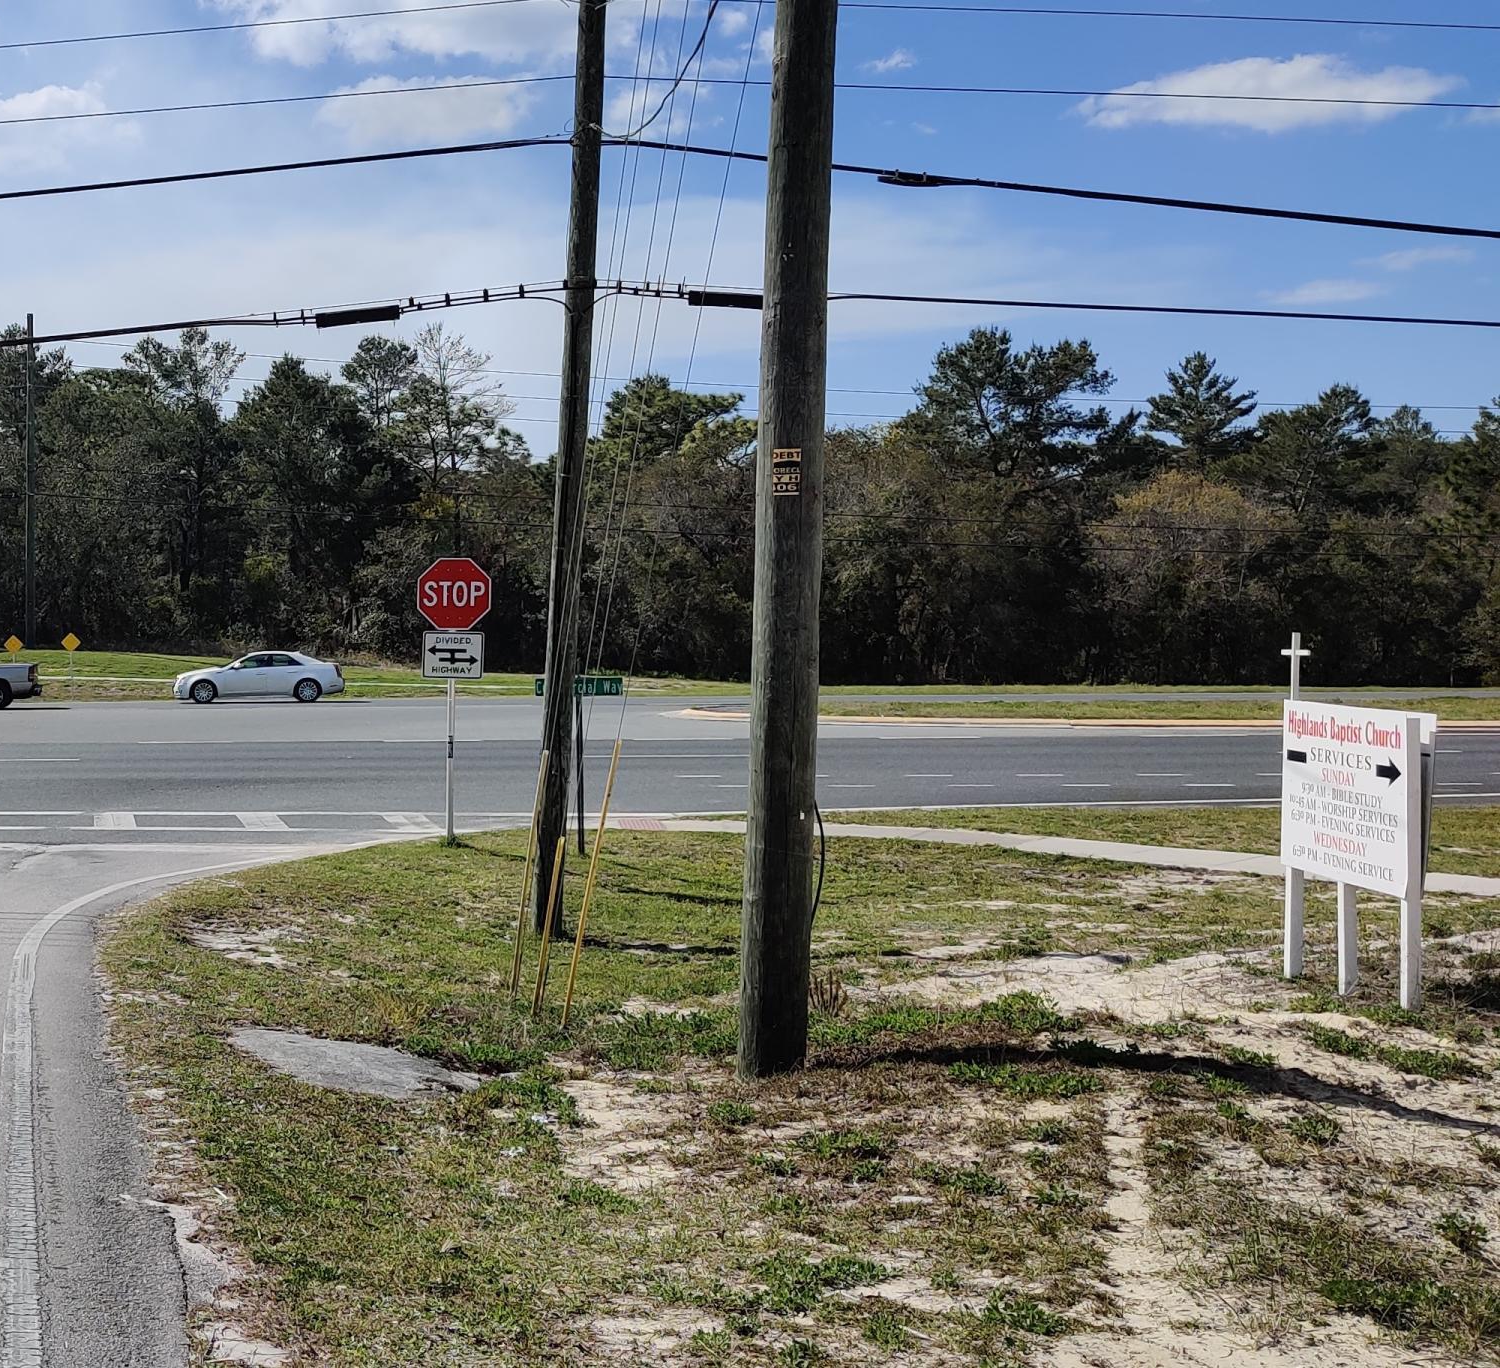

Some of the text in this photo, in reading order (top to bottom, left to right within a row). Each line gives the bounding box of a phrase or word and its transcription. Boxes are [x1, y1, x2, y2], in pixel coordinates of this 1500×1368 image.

[423, 581, 485, 607] STOP
[435, 636, 472, 645] DIVIDED
[431, 666, 473, 674] HIGHWAY
[603, 680, 623, 694] Way
[1288, 710, 1401, 749] Highlands Baptist Church
[1310, 747, 1372, 771] SERVICES
[1322, 768, 1356, 787] SUNDAY
[1315, 785, 1326, 798] AM
[1332, 788, 1354, 804] BIBLE
[1355, 792, 1383, 809] STUDY
[1305, 798, 1316, 811] AM
[1321, 800, 1357, 820] WORSHIP
[1358, 808, 1398, 828] SERVICES
[1305, 811, 1316, 825] PM
[1322, 815, 1354, 835] EVENING
[1356, 823, 1396, 843] SERVICES
[1313, 831, 1367, 857] WEDNESDAY
[1307, 847, 1318, 862] PM
[1323, 852, 1357, 873] EVENING
[1358, 861, 1394, 881] SERVICE
